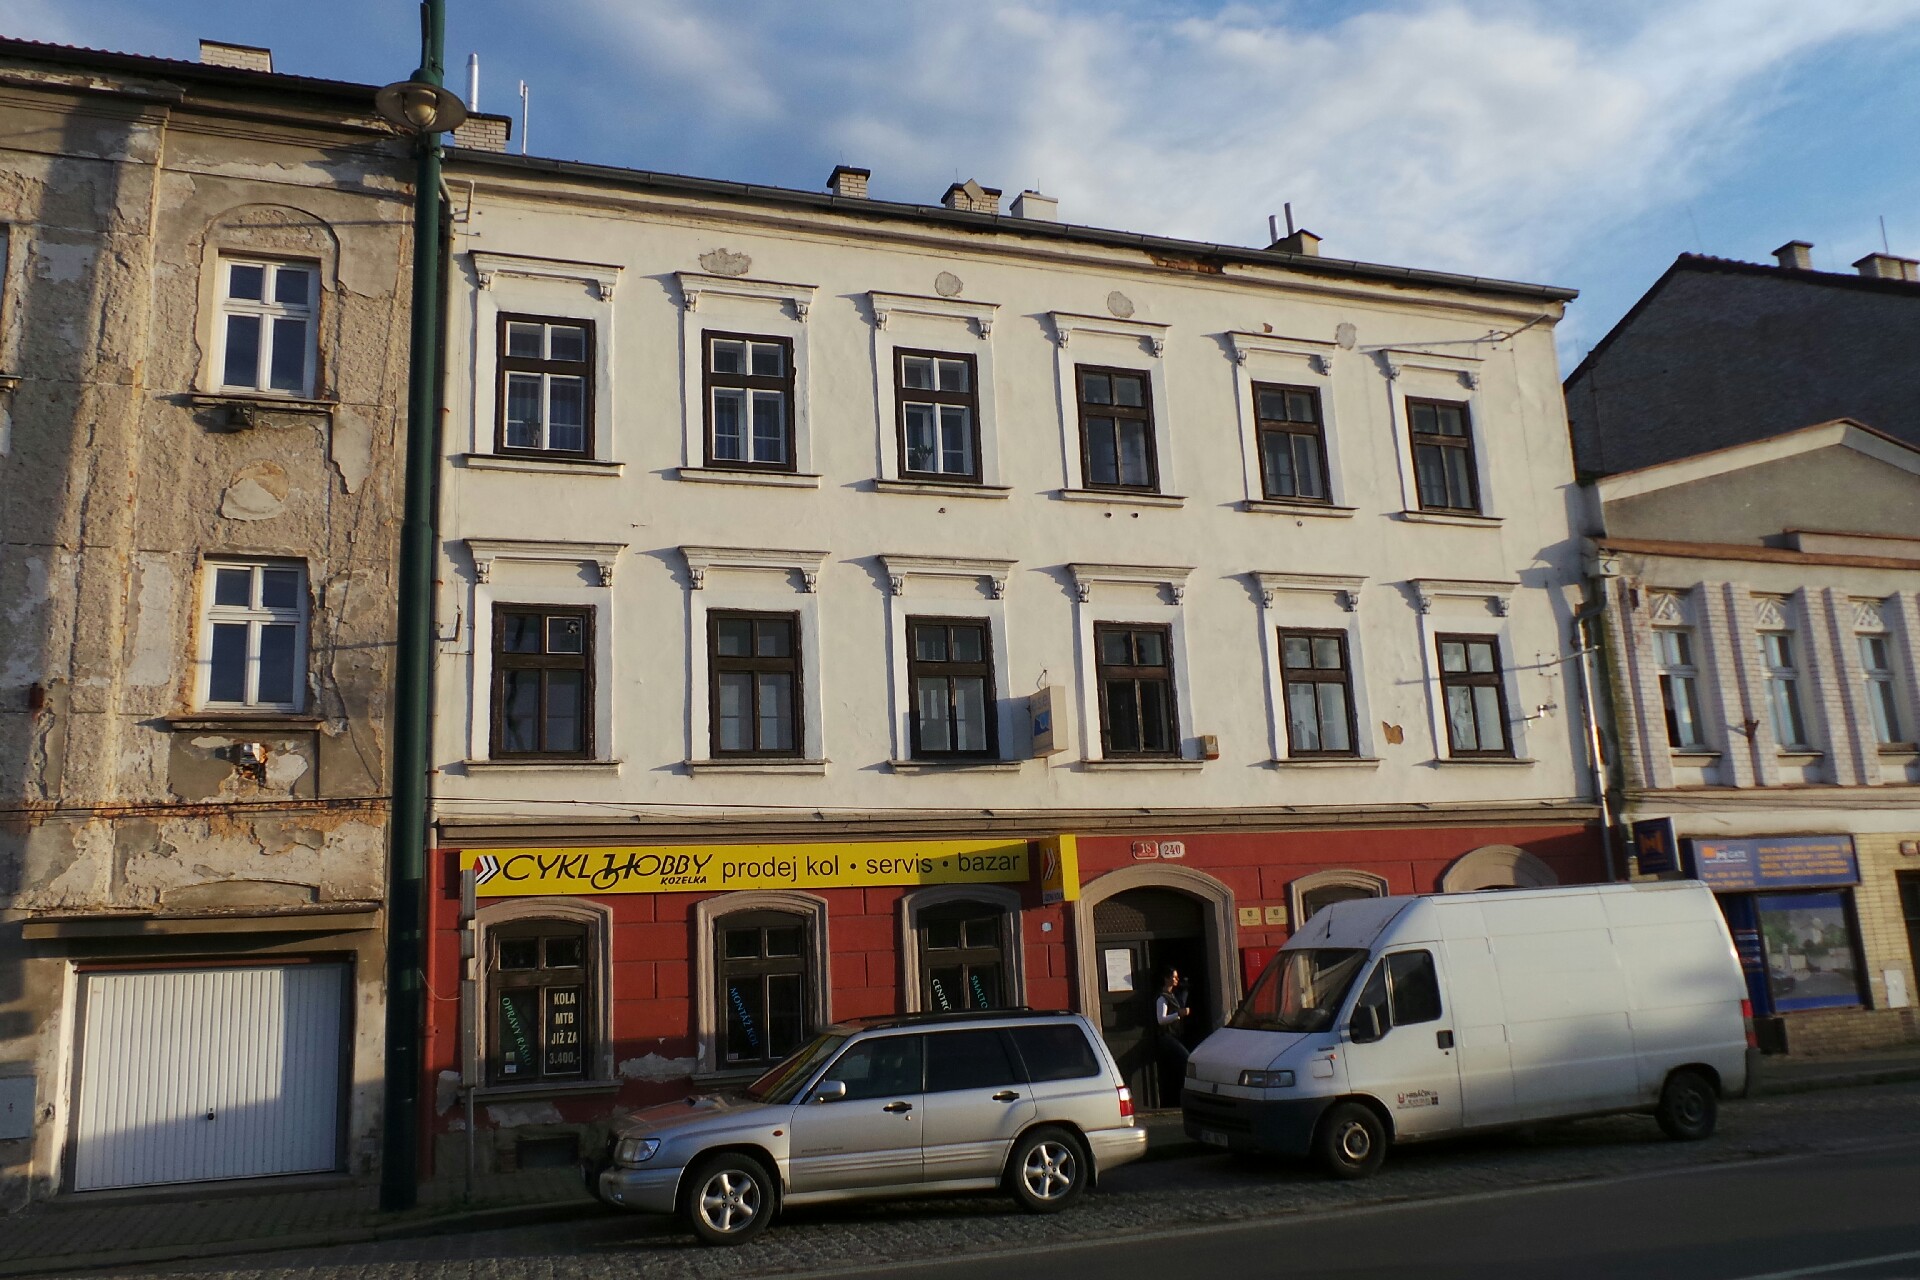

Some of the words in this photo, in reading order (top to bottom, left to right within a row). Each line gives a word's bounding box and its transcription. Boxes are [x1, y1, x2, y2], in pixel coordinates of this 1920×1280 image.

[1140, 842, 1152, 854] 18
[1163, 844, 1181, 856] 240
[722, 855, 798, 883] prodej
[806, 855, 839, 876] kol
[866, 853, 933, 874] servis
[957, 852, 1021, 872] bazar
[660, 875, 707, 885] KOZELKA
[554, 992, 576, 1006] KOLA
[501, 997, 522, 1036] OPRAVY
[555, 1012, 574, 1025] MTB
[551, 1029, 565, 1045] JIŽ
[567, 1031, 578, 1044] ZA
